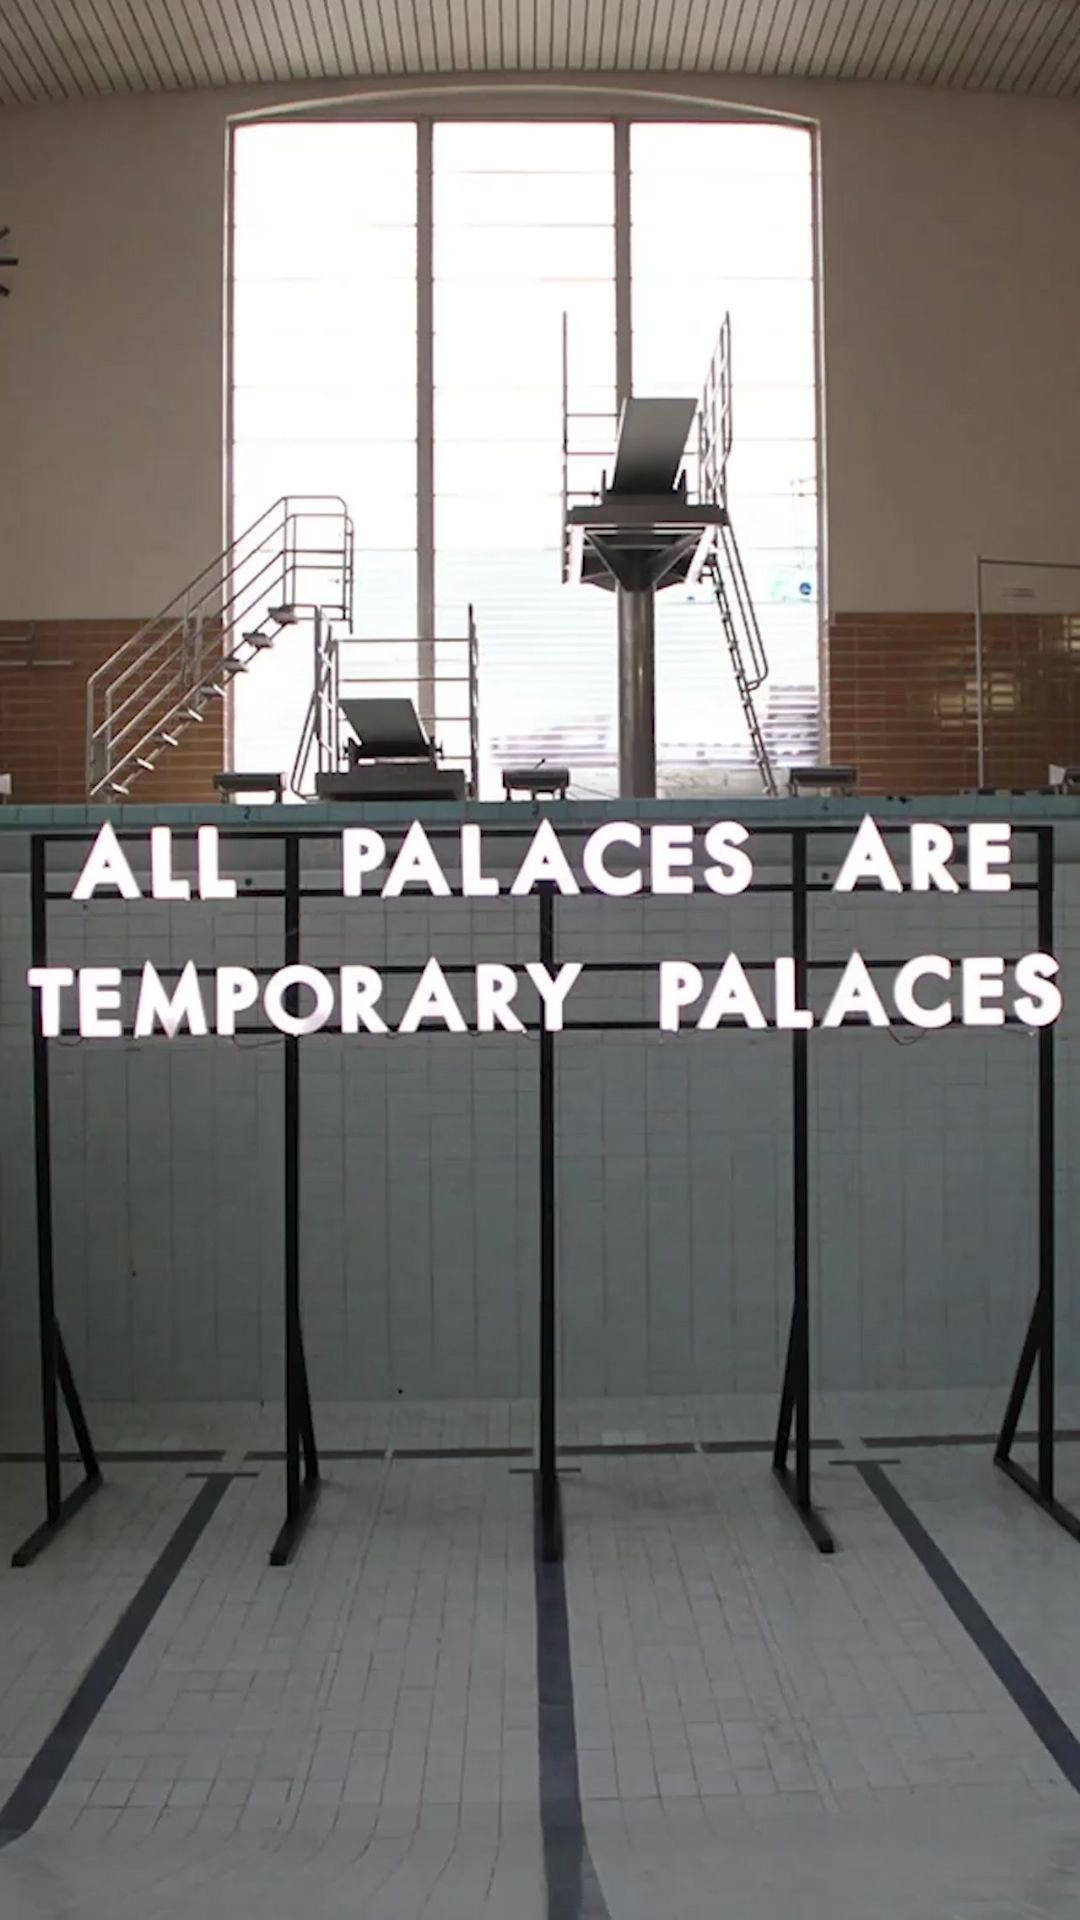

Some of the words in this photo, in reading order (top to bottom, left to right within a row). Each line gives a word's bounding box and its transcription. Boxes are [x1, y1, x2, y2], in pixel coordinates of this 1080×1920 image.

[73, 822, 236, 900] ALL
[343, 819, 752, 898] PALACES
[834, 814, 1011, 893] ARE
[28, 957, 582, 1038] TEMPORARY
[660, 952, 1061, 1032] PALACES
